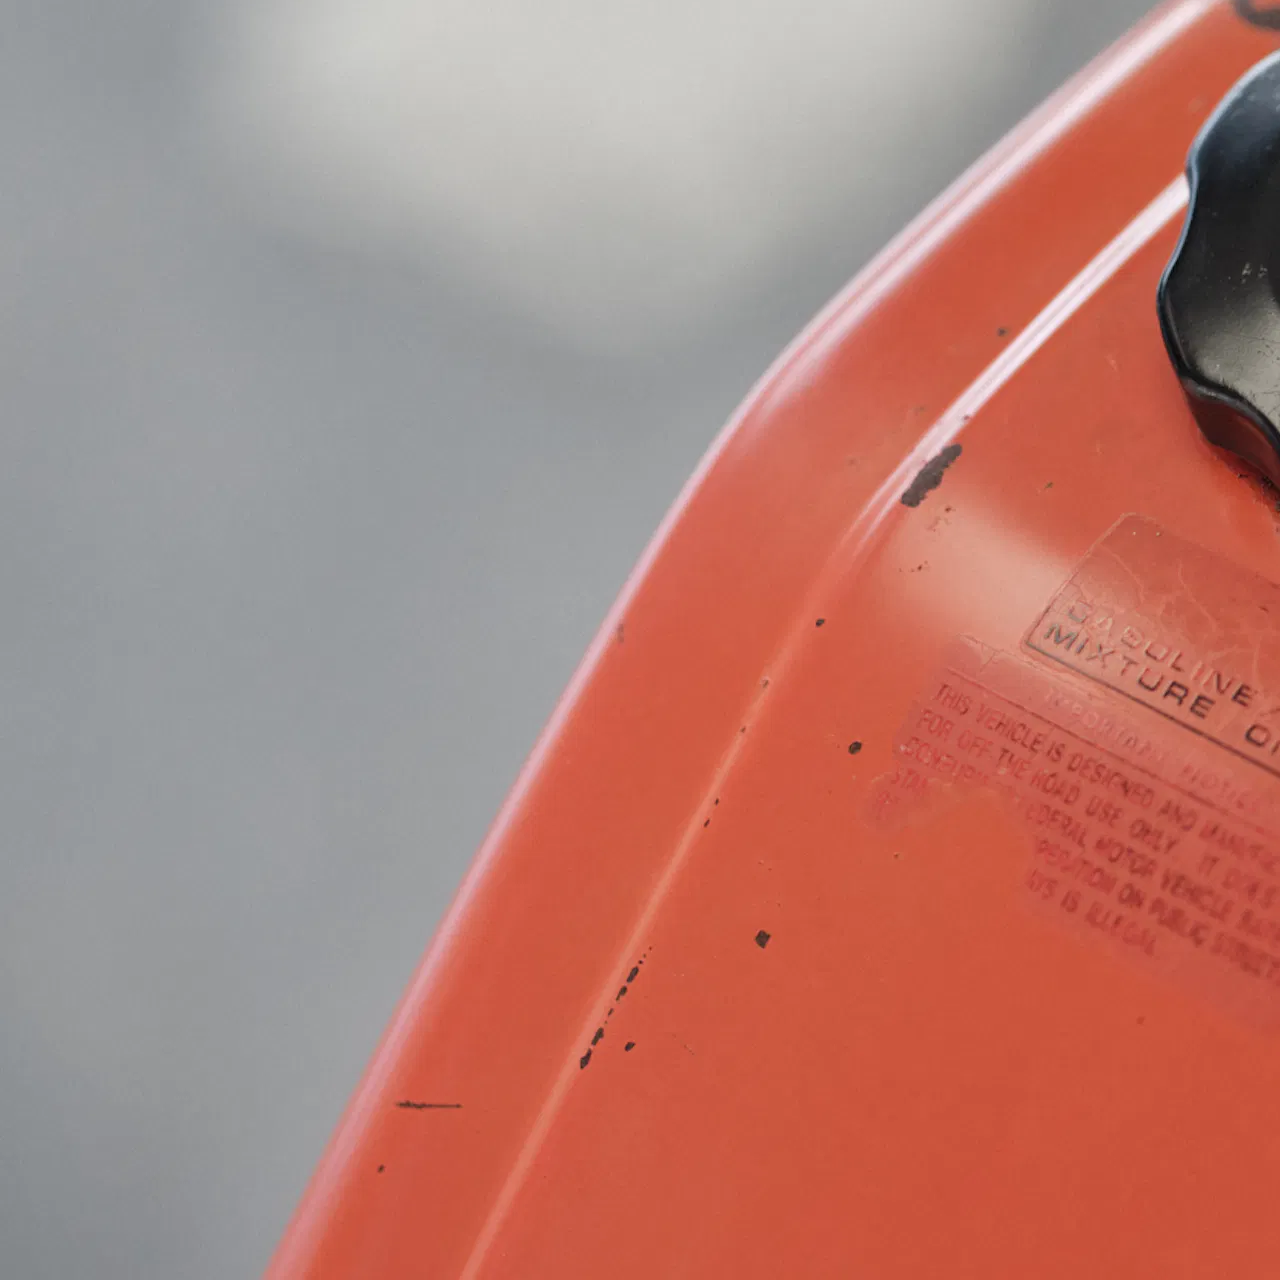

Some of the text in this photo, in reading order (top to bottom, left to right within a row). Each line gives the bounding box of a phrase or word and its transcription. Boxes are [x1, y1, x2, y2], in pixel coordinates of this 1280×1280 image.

[1042, 621, 1214, 723] MIXTURE
[918, 709, 956, 742] FOR
[1086, 795, 1125, 829] USE
[935, 682, 974, 716] THIS
[975, 703, 1047, 754] VEHICLE
[1047, 740, 1069, 765] IS
[1068, 751, 1158, 812] DESIGNED
